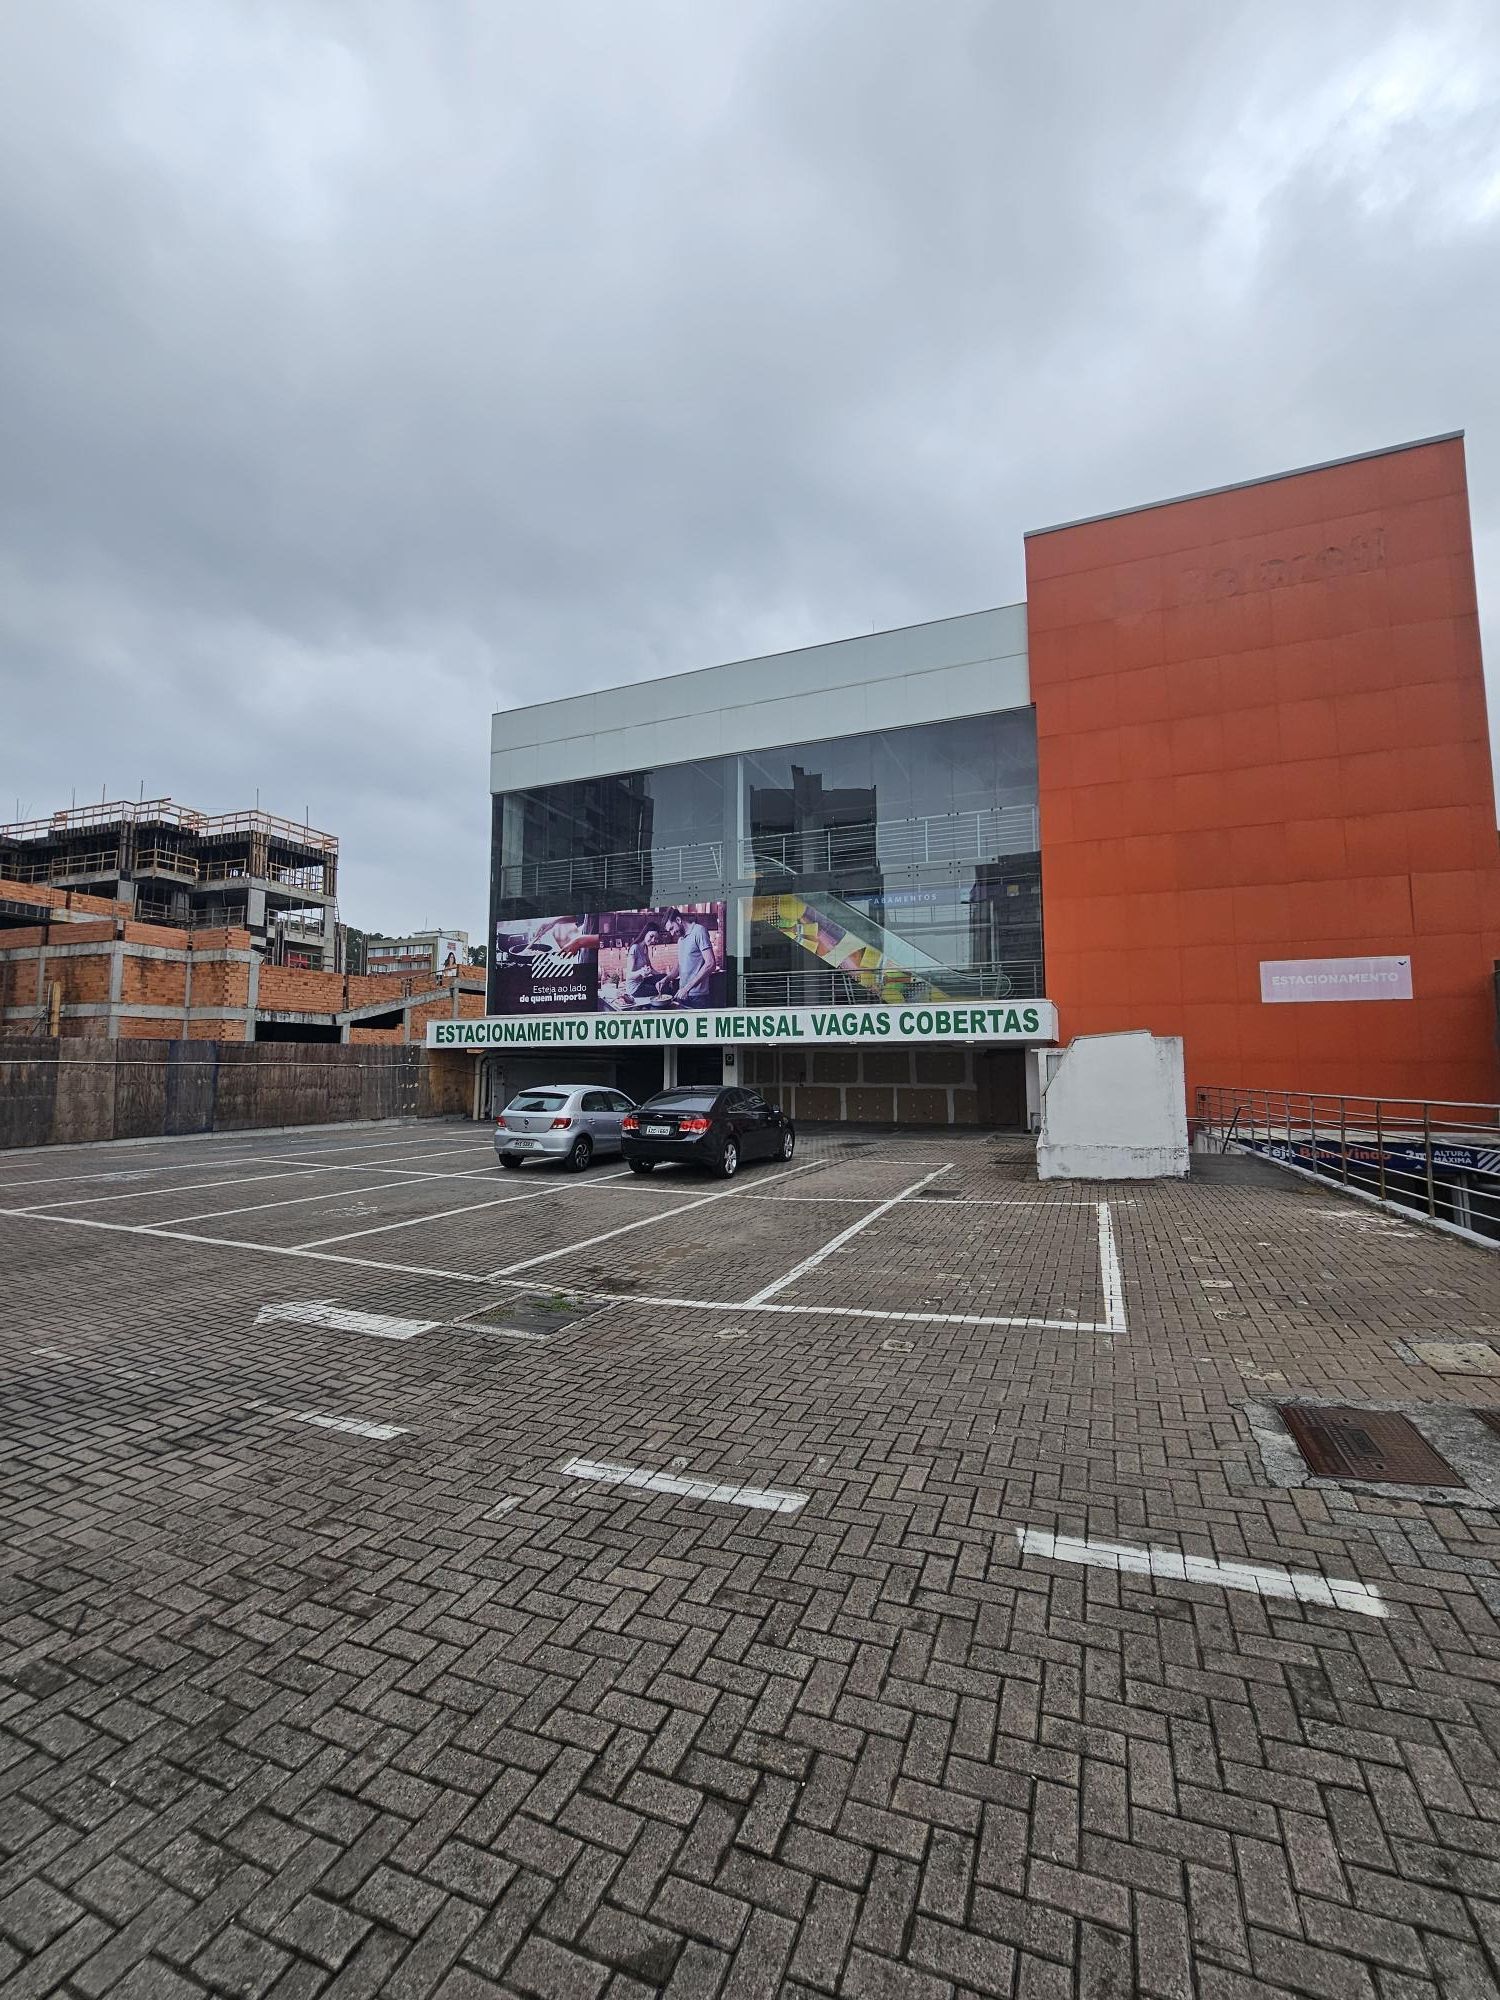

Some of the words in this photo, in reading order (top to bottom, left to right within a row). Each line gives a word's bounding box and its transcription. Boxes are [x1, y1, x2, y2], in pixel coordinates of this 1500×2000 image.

[1271, 972, 1399, 986] ESTACIONAMENTO
[533, 985, 556, 994] Esteja
[557, 985, 568, 993] ao
[569, 984, 587, 992] lado
[519, 994, 529, 1003] de
[531, 994, 553, 1004] quem
[553, 993, 587, 1003] importa
[435, 1020, 589, 1044] ESTACIONAMENTO
[595, 1017, 689, 1041] ROTATIVO
[696, 1017, 708, 1039] E
[715, 1013, 804, 1038] MENSAL
[811, 1012, 891, 1036] VAGAS
[899, 1008, 1040, 1035] COBERTAS
[1261, 1145, 1296, 1160] Seja
